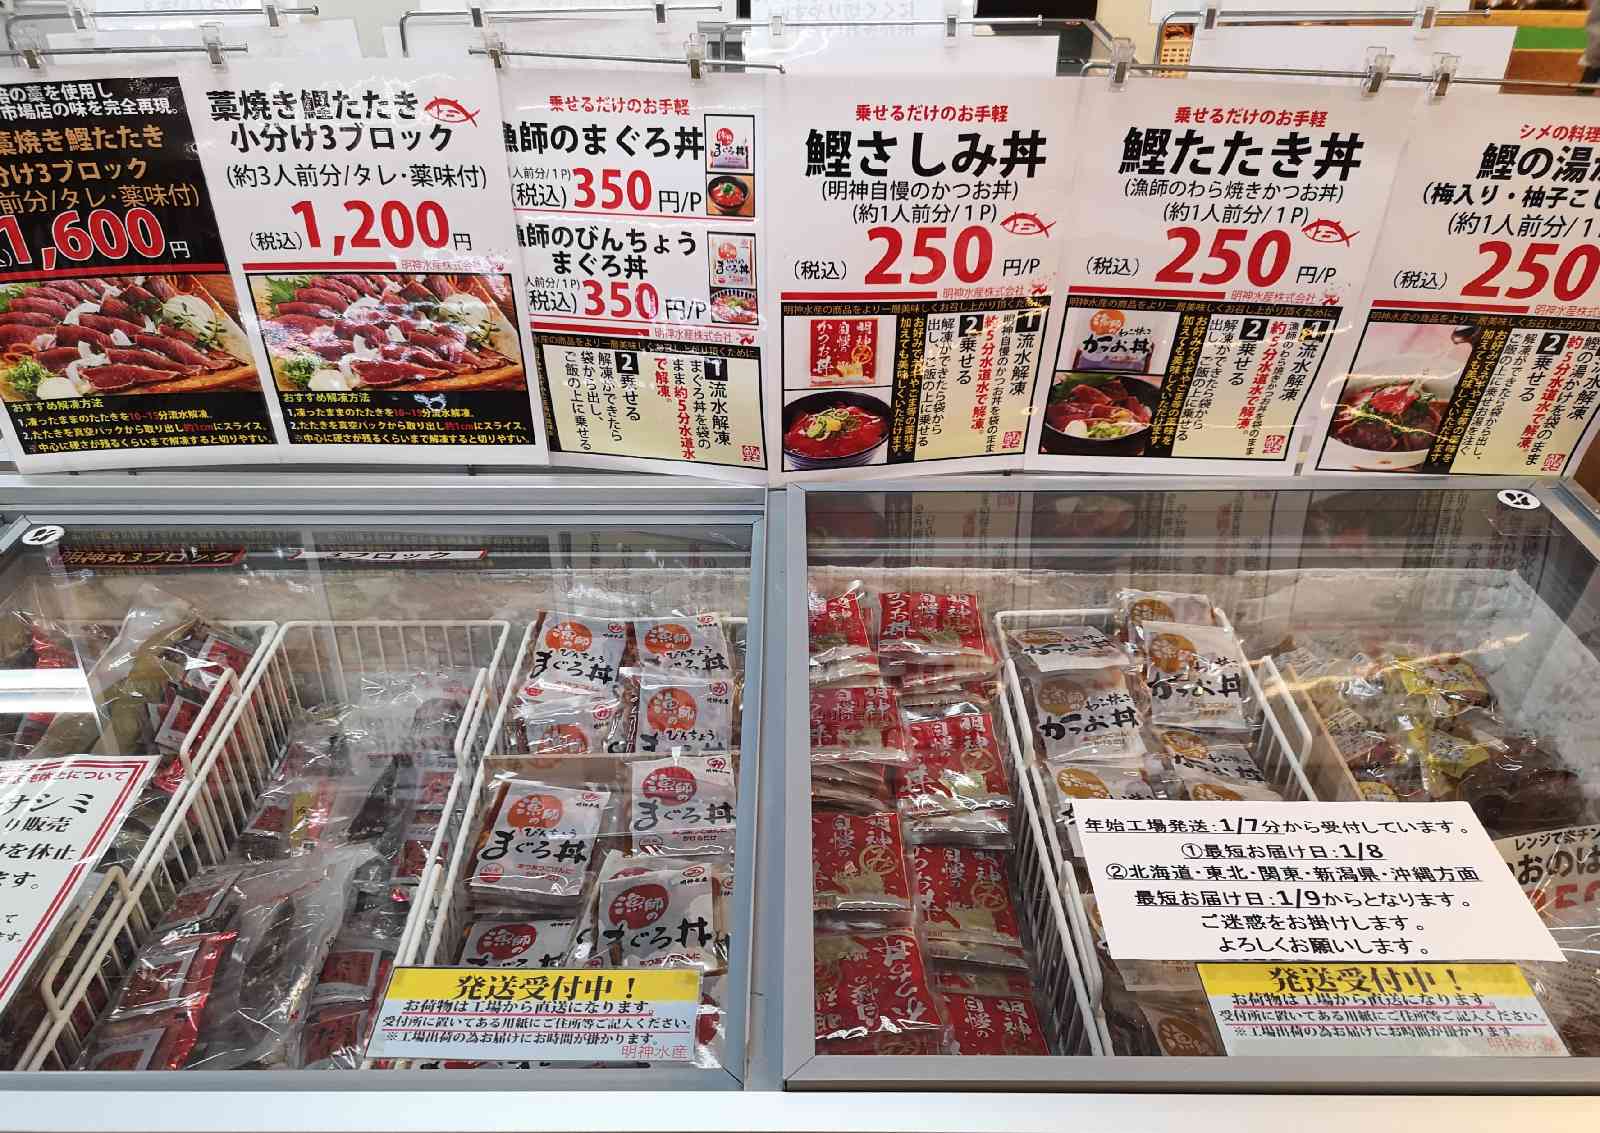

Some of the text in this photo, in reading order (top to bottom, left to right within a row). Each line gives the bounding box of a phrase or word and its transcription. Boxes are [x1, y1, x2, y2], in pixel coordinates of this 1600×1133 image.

[206, 89, 418, 121] 藁焼き鰹たたき
[549, 95, 690, 116] 乗せるだけのお手軽
[856, 104, 1009, 122] 乗せるだけのお手軽
[1174, 106, 1328, 127] 乗せるだけのお手軽
[230, 122, 453, 153] 小分け3ブロック
[805, 129, 1047, 178] 鰹さしみ丼
[1118, 127, 1364, 181] 鰹たたき丼
[511, 167, 703, 214] (税込) 350 円/P
[822, 181, 1019, 201] (明神自慢のかつお丼)
[1124, 178, 1344, 203] (漁師のわら焼きかつお丼)
[169, 240, 190, 259] 円
[249, 200, 472, 257] (税込) 1,200 円
[552, 250, 648, 280] まぐろ丼
[794, 224, 1040, 285] (税込) 250 円/P
[1086, 226, 1337, 287] (税込) 250 円/P
[1393, 241, 1600, 302] (税込) 250
[582, 279, 660, 320] 350
[665, 298, 707, 320] 円/P
[956, 337, 977, 385] 乗せる
[1009, 334, 1035, 396] 流水解凍
[1227, 341, 1256, 386] 乗せる
[1279, 343, 1319, 401] 流水解凍
[1519, 357, 1553, 402] 乗せる
[564, 351, 592, 451] ご飯の上に乗せる
[598, 351, 623, 442] 解凍ができたら
[621, 374, 641, 421] 乗せる
[709, 381, 731, 446] 流水解凍
[1039, 706, 1140, 740] かつお丼
[634, 799, 736, 831] まぐろ丼
[480, 829, 587, 864] まぐろ丼
[1201, 913, 1424, 931] ご迷惑をお掛けします。
[1219, 936, 1429, 955] よろしくお願いします。
[620, 1045, 689, 1060] 明神水産
